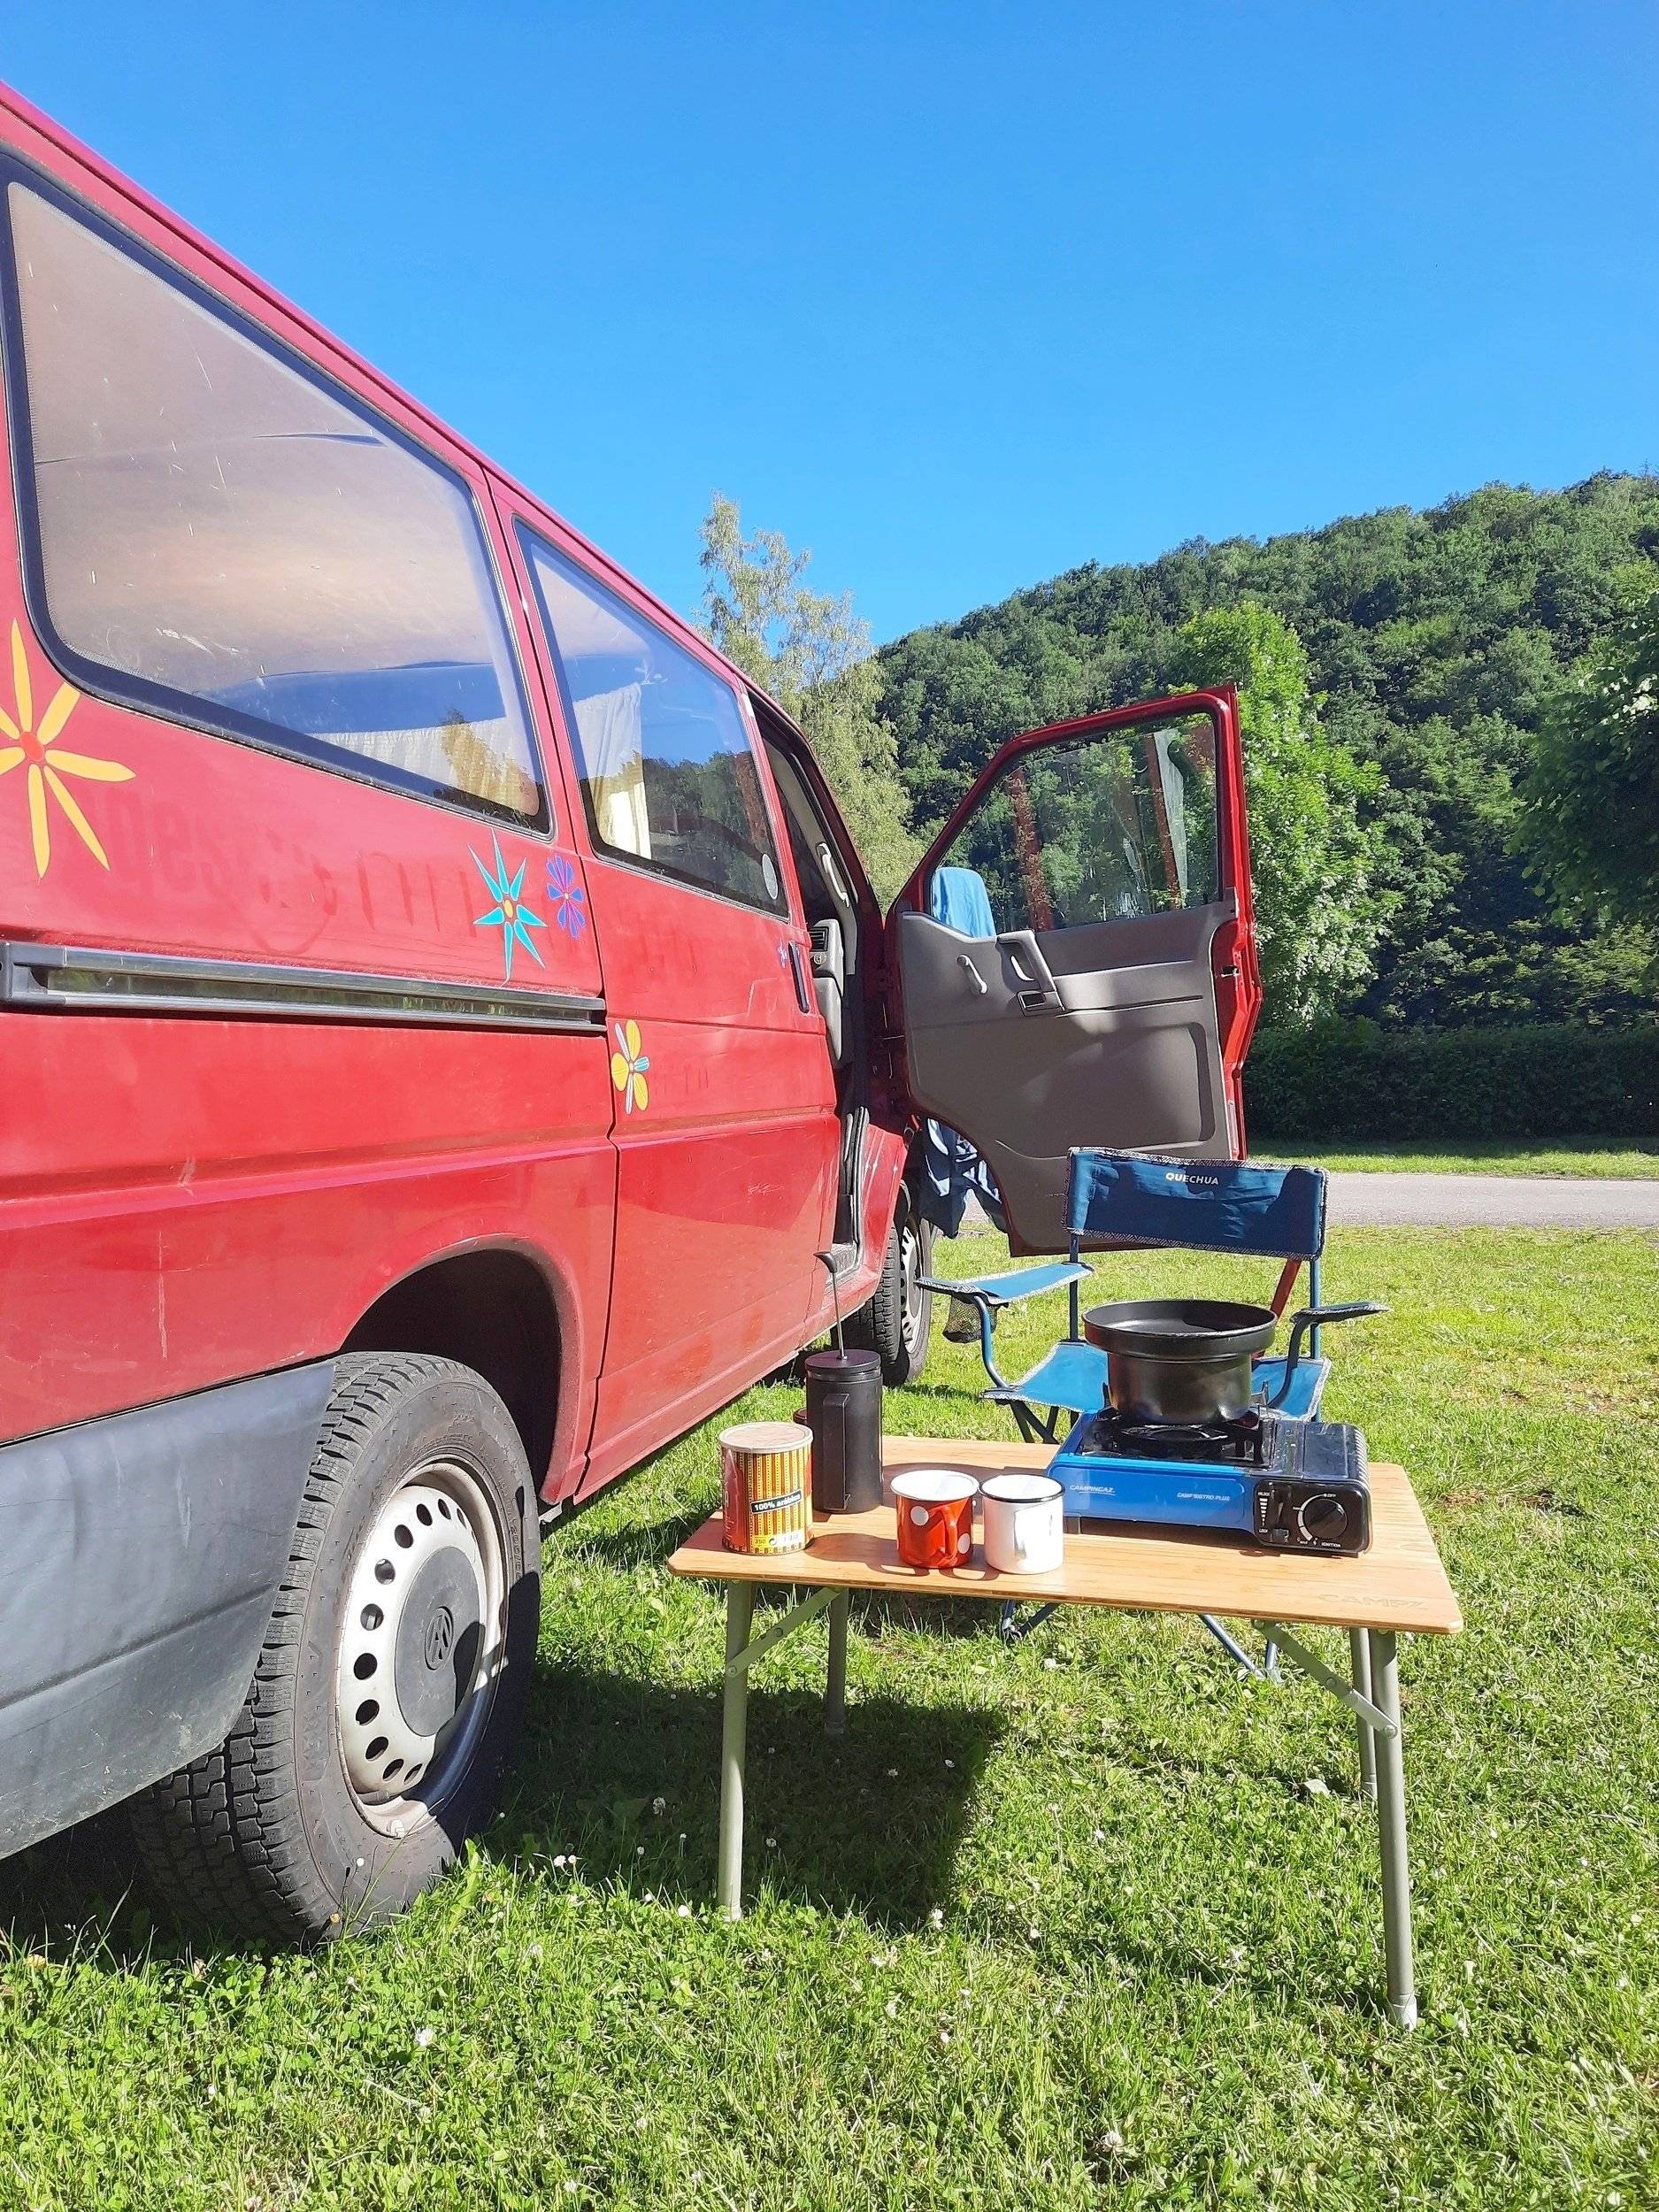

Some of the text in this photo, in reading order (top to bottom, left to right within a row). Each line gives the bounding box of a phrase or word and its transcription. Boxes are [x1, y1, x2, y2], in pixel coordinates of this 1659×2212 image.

[1165, 1171, 1219, 1185] QUECHUA
[1069, 1485, 1116, 1494] CAMPINGAZ
[755, 1501, 776, 1511] 100%
[1317, 1594, 1429, 1610] CAMPZ
